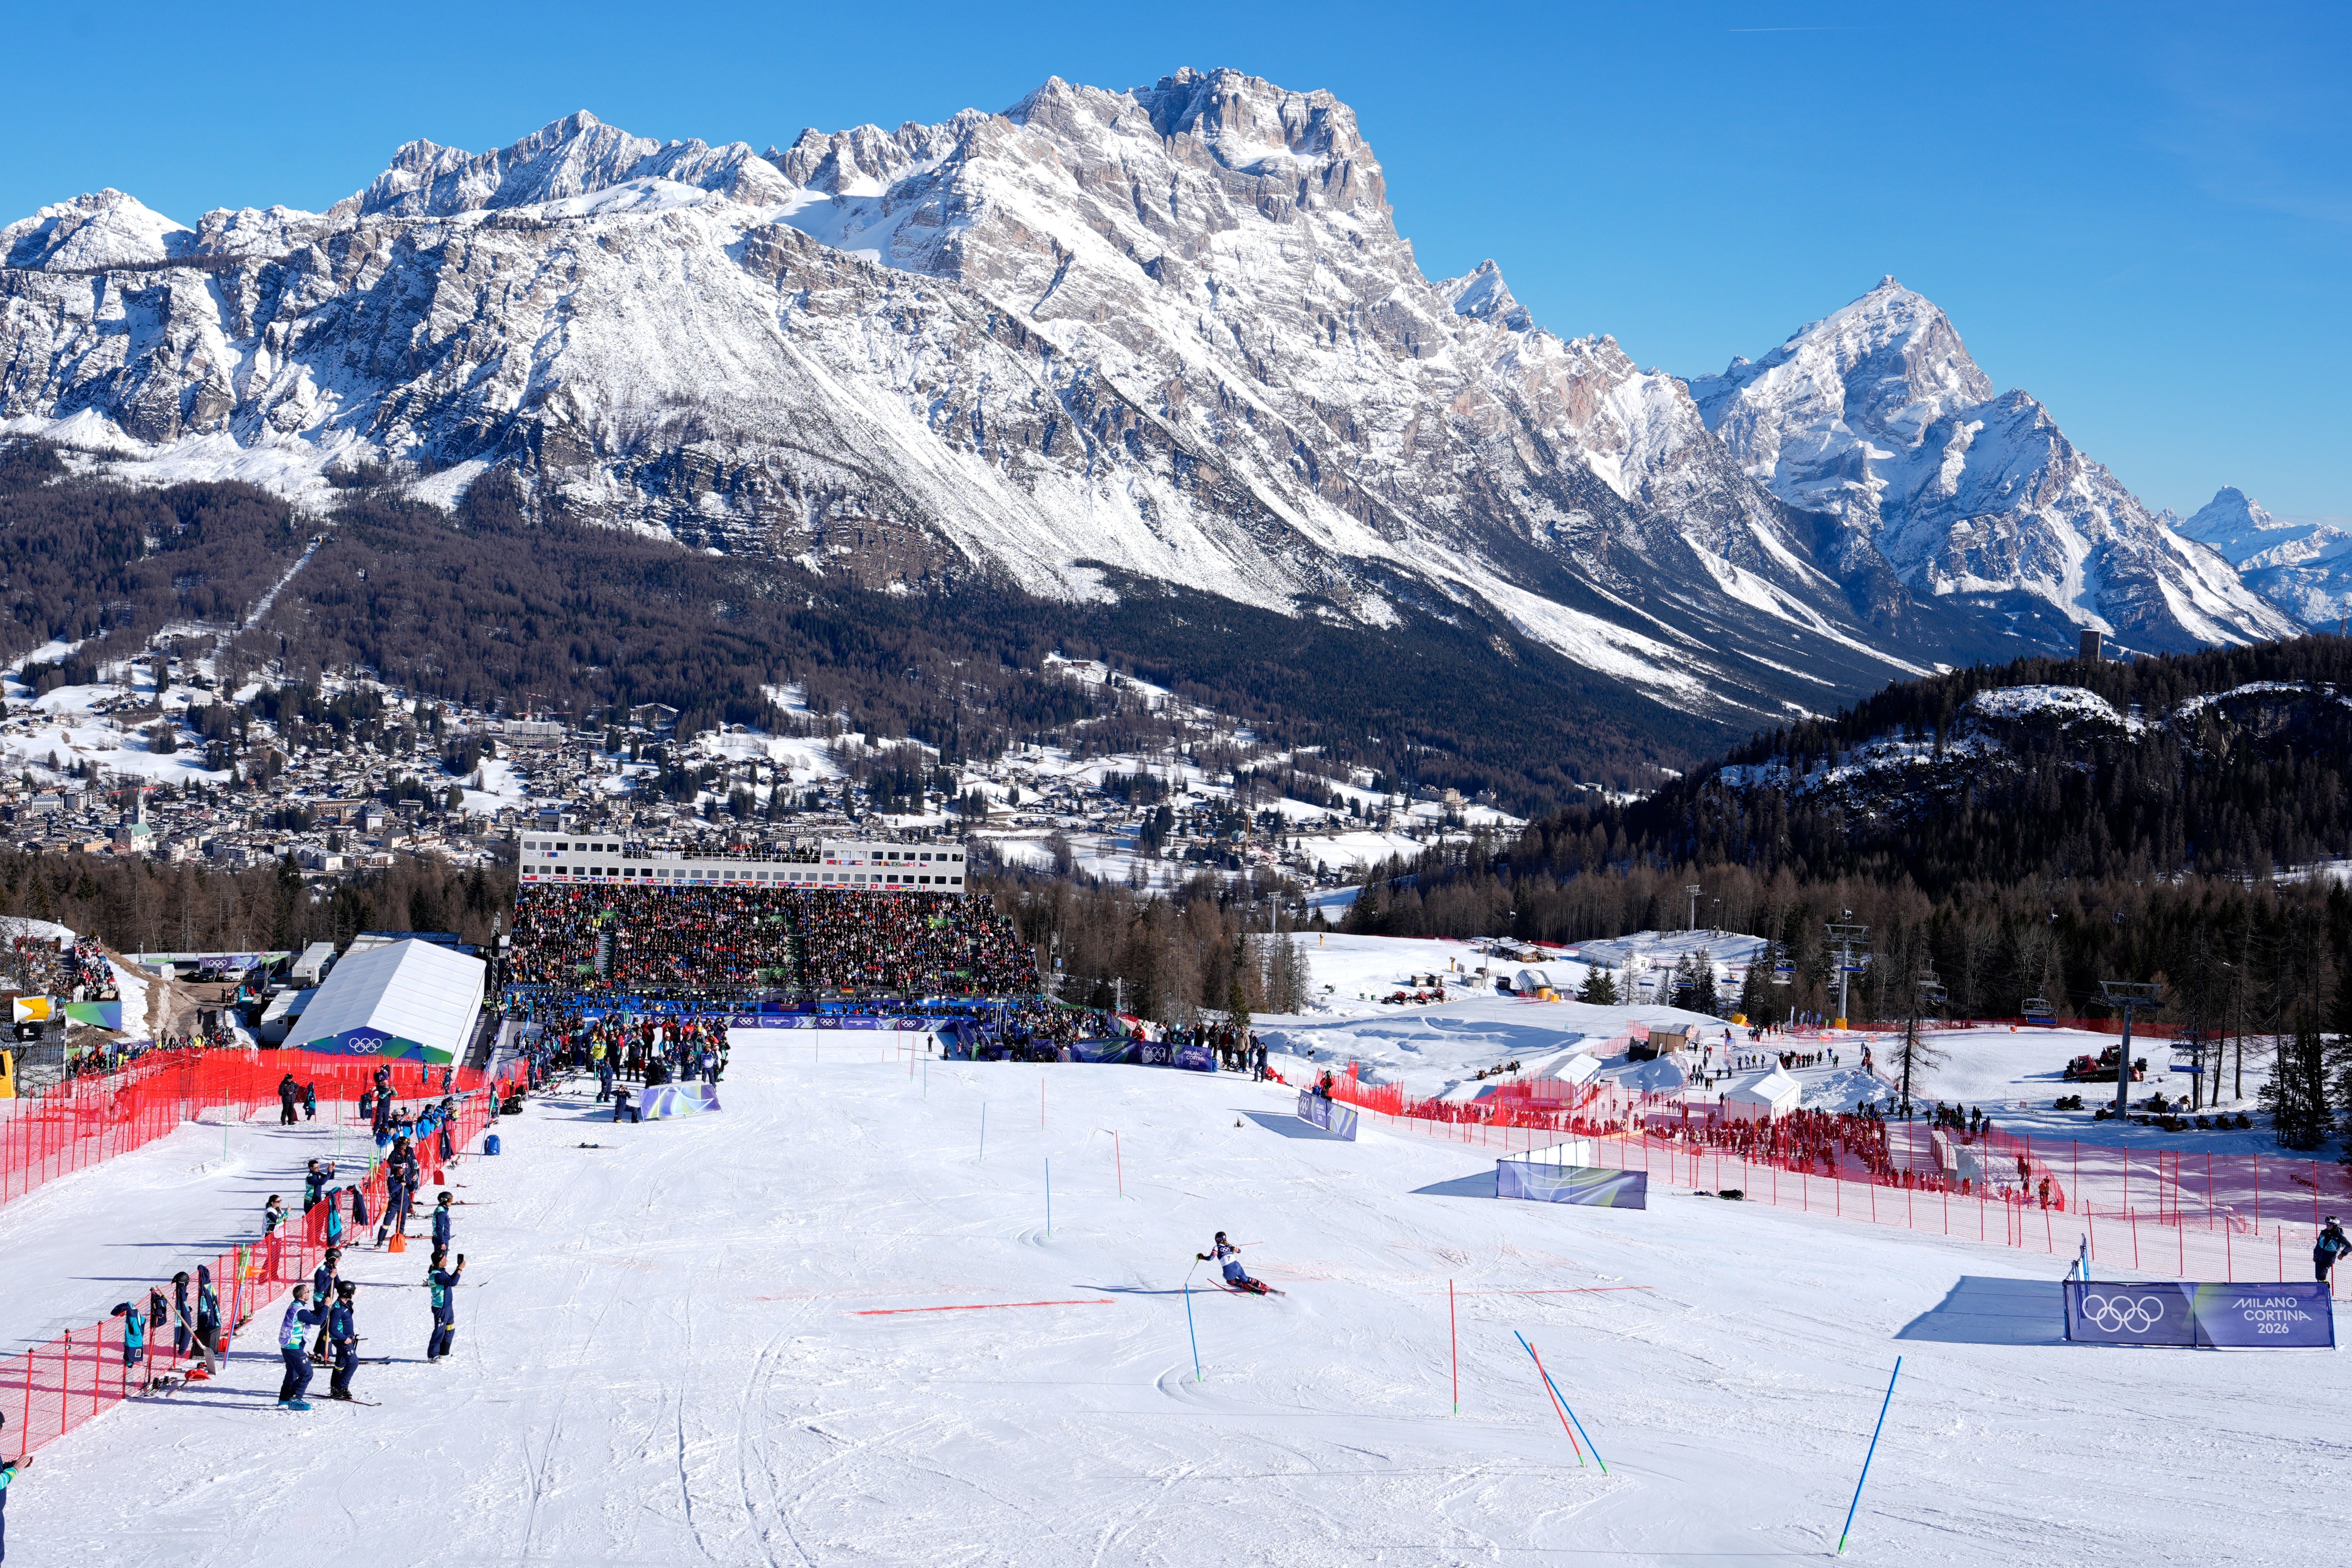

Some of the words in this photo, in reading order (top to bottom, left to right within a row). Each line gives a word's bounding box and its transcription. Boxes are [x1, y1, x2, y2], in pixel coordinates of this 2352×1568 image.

[2232, 1297, 2297, 1308] MILANO
[2244, 1310, 2313, 1321] CORTINA
[2258, 1323, 2289, 1334] 2026
